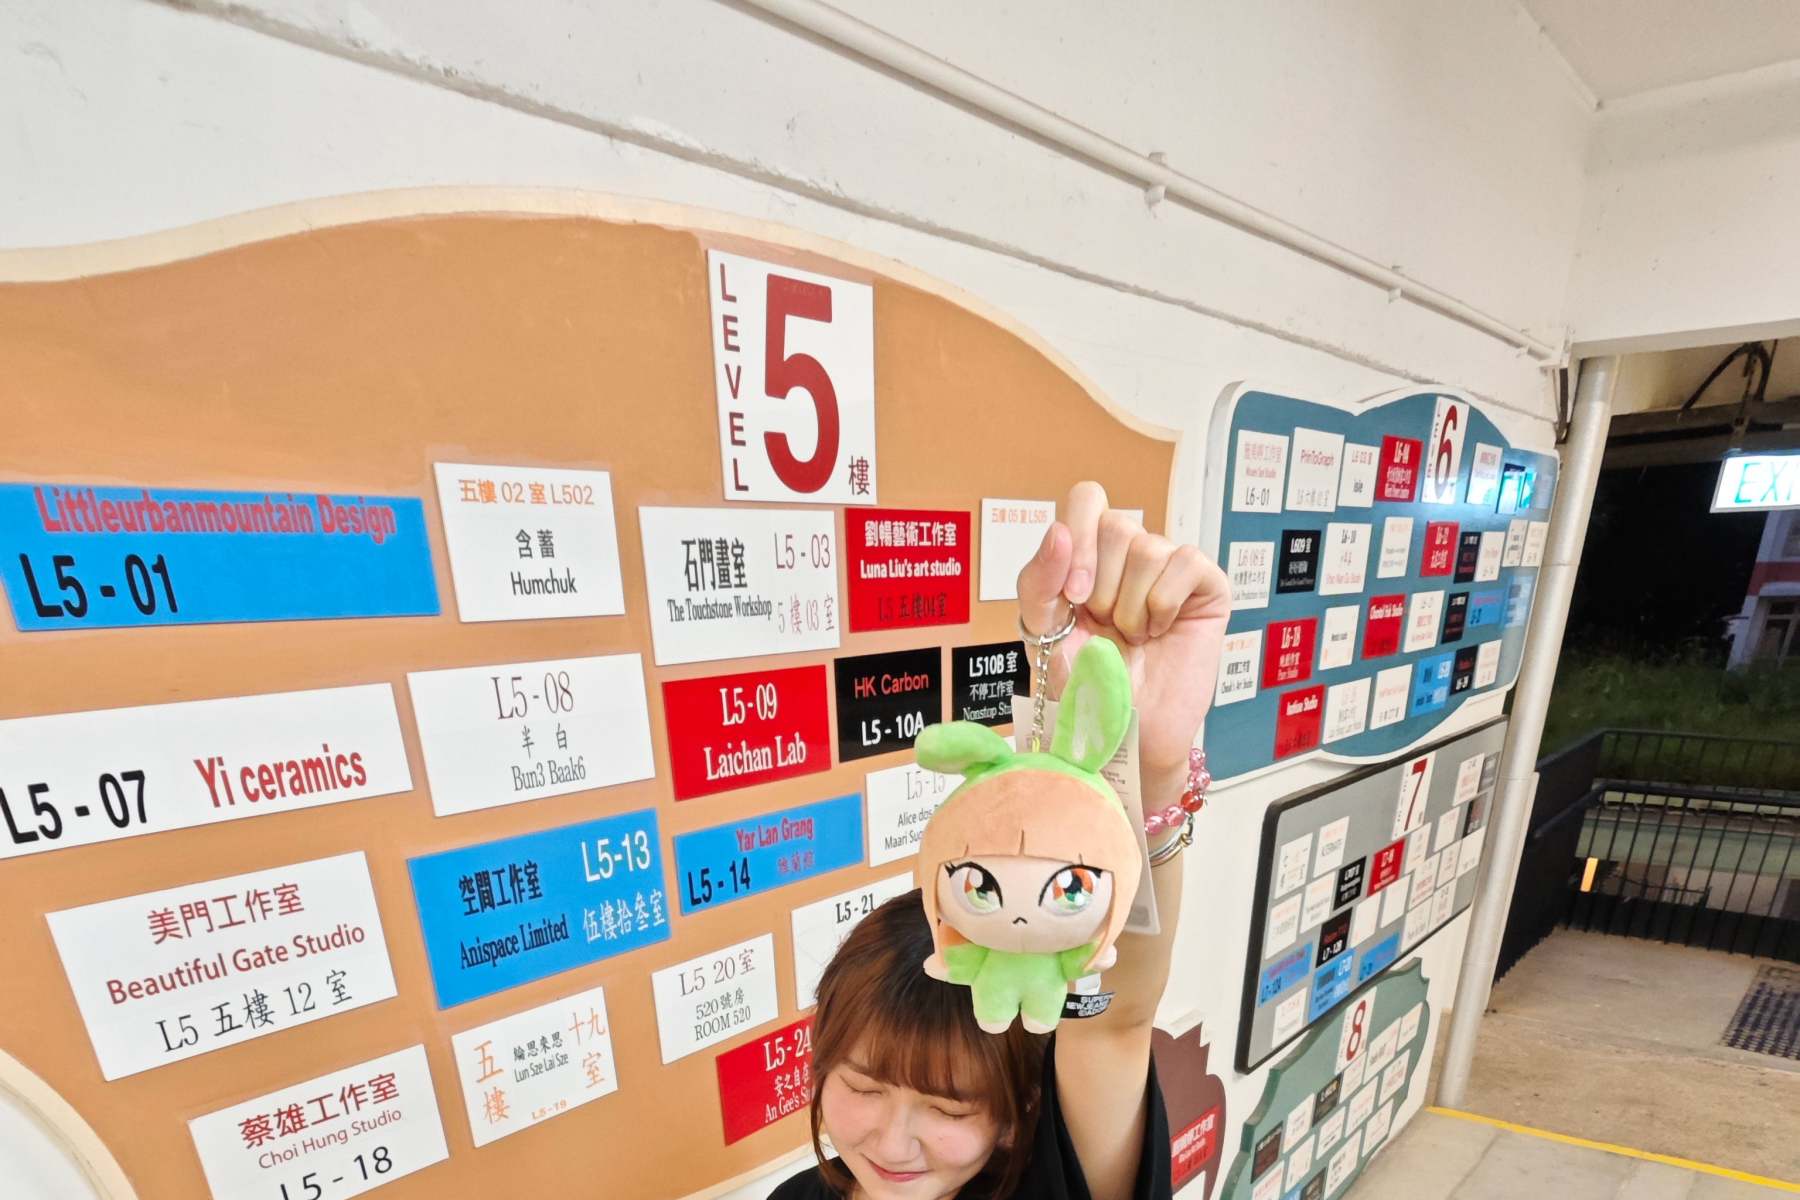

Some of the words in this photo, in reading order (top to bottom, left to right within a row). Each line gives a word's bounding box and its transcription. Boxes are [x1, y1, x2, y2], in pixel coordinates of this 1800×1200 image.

[719, 262, 749, 492] LEVEL
[763, 273, 840, 494] 5
[848, 455, 870, 496] 樓
[1435, 405, 1457, 499] 6
[1734, 461, 1800, 503] EXI
[34, 487, 314, 534] Littleurbanmountain
[316, 494, 396, 544] Design
[515, 529, 555, 560] 含蓄
[681, 536, 748, 592] 石門畫室
[860, 558, 887, 579] Luna
[888, 558, 913, 578] Liu's
[914, 560, 930, 577] art
[930, 557, 961, 577] studio
[20, 553, 88, 618] L5
[124, 553, 178, 615] 01
[510, 567, 578, 596] Humchuk
[667, 598, 684, 622] The
[685, 596, 733, 621] Touchstone
[734, 595, 772, 621] Workshop
[854, 676, 877, 699] HK
[881, 672, 929, 695] Carbon
[963, 704, 997, 721] Nonstop
[998, 702, 1012, 716] Stu
[193, 756, 235, 808] Yi
[240, 743, 367, 803] ceramics
[511, 762, 546, 791] Bun3
[547, 755, 587, 785] Baak6
[704, 740, 773, 781] Laichan
[774, 732, 806, 768] Lab
[0, 783, 63, 844] L5
[99, 770, 147, 829] 07
[898, 811, 917, 827] Alice
[1404, 758, 1428, 832] 7
[736, 829, 755, 852] Yar
[758, 825, 779, 847] Lan
[781, 817, 814, 841] Grang
[147, 883, 305, 945] 美門工作室
[458, 860, 543, 917] 空間工作室
[106, 953, 228, 1005] Beautiful
[232, 945, 289, 974] Gate
[292, 925, 365, 959] Studio
[460, 924, 519, 970] Anispace
[522, 913, 570, 952] Limited
[678, 967, 706, 997] L5
[712, 957, 736, 985] 20
[739, 947, 756, 976] 室
[155, 1014, 200, 1053] L5
[210, 988, 276, 1037] 五樓
[282, 981, 317, 1018] 12
[325, 968, 353, 1006] 室
[694, 1017, 731, 1041] ROOM
[733, 1007, 752, 1030] 520
[1346, 1000, 1366, 1061] 8
[514, 1063, 531, 1084] Lun
[530, 1057, 544, 1077] Sze
[544, 1054, 556, 1073] Lai
[555, 1051, 569, 1069] Sze
[238, 1072, 400, 1149] 蔡雄工作室
[258, 1145, 299, 1170] Choi
[301, 1128, 349, 1154] Hung
[351, 1107, 402, 1137] Studio
[353, 1145, 393, 1181] 18
